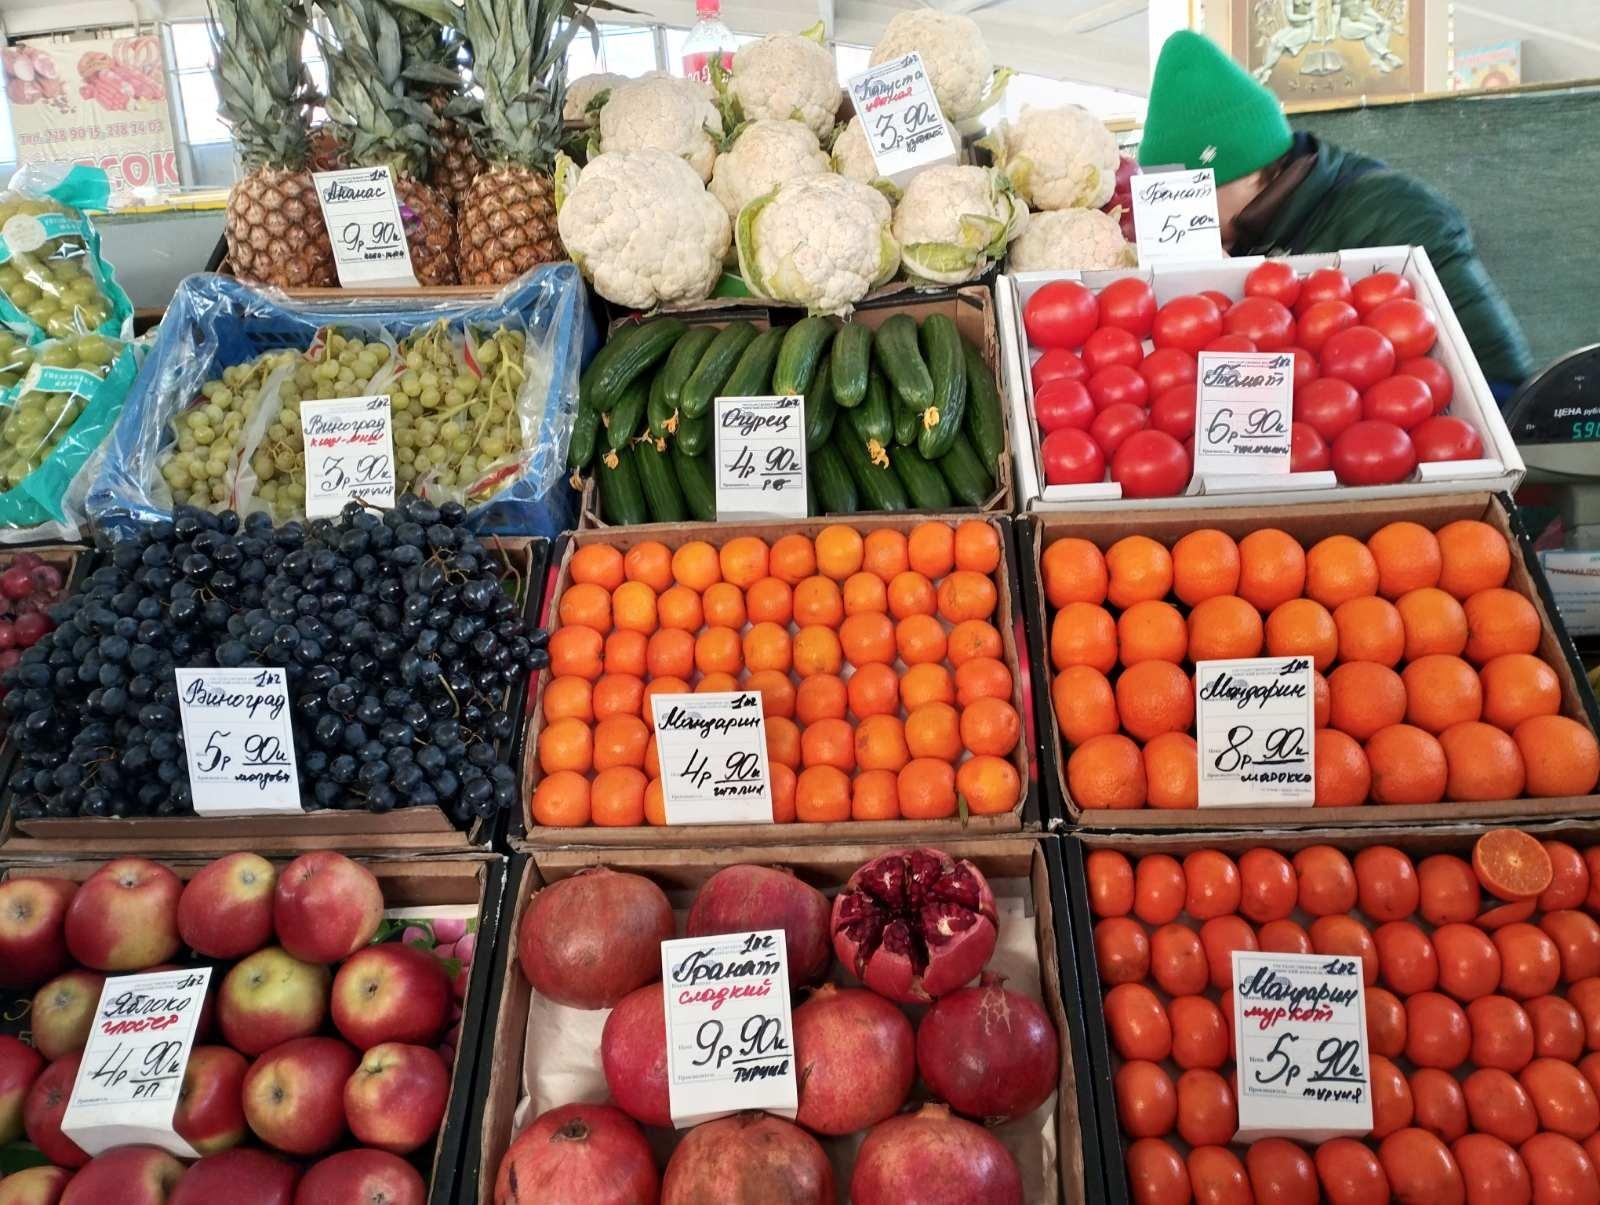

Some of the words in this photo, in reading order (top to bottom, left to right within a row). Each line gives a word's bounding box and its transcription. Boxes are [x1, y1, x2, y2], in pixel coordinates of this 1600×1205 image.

[855, 70, 924, 101] Капуста
[876, 113, 904, 150] 3р
[325, 181, 386, 202] Ананас
[343, 222, 365, 252] 9р
[372, 221, 401, 244] 90к
[1158, 214, 1186, 243] 5р
[304, 414, 386, 437] Виноград
[722, 408, 791, 436] Огурец
[1208, 408, 1239, 444] 6р
[1244, 408, 1288, 434] 90к
[1554, 407, 1581, 418] ЦЕНА
[321, 456, 351, 491] 3р
[355, 454, 393, 482] 90к
[728, 445, 756, 478] 4р
[765, 446, 802, 471] 90к
[253, 670, 281, 687] 1кг
[1200, 672, 1306, 709] Мандарин
[182, 678, 286, 720] Виноград
[659, 706, 760, 738] Мандарин
[197, 730, 231, 772] 5р
[1214, 725, 1252, 772] 8р
[1263, 727, 1309, 759] 90к
[680, 748, 712, 789] 4р
[725, 751, 760, 780] 90к
[740, 934, 776, 955] 1кг
[177, 974, 203, 990] 1кг
[672, 948, 781, 985] Гранат
[1323, 959, 1358, 975] 1кг
[104, 992, 192, 1017] Яблоко
[678, 978, 773, 1011] сладкий
[1238, 966, 1359, 1012] Мандарин
[692, 1019, 733, 1069] 9р
[739, 1014, 790, 1056] 90к
[92, 1042, 128, 1087] 4р
[140, 1041, 183, 1076] 90к
[1255, 1032, 1301, 1086] 5р
[1313, 1037, 1363, 1079] 90к
